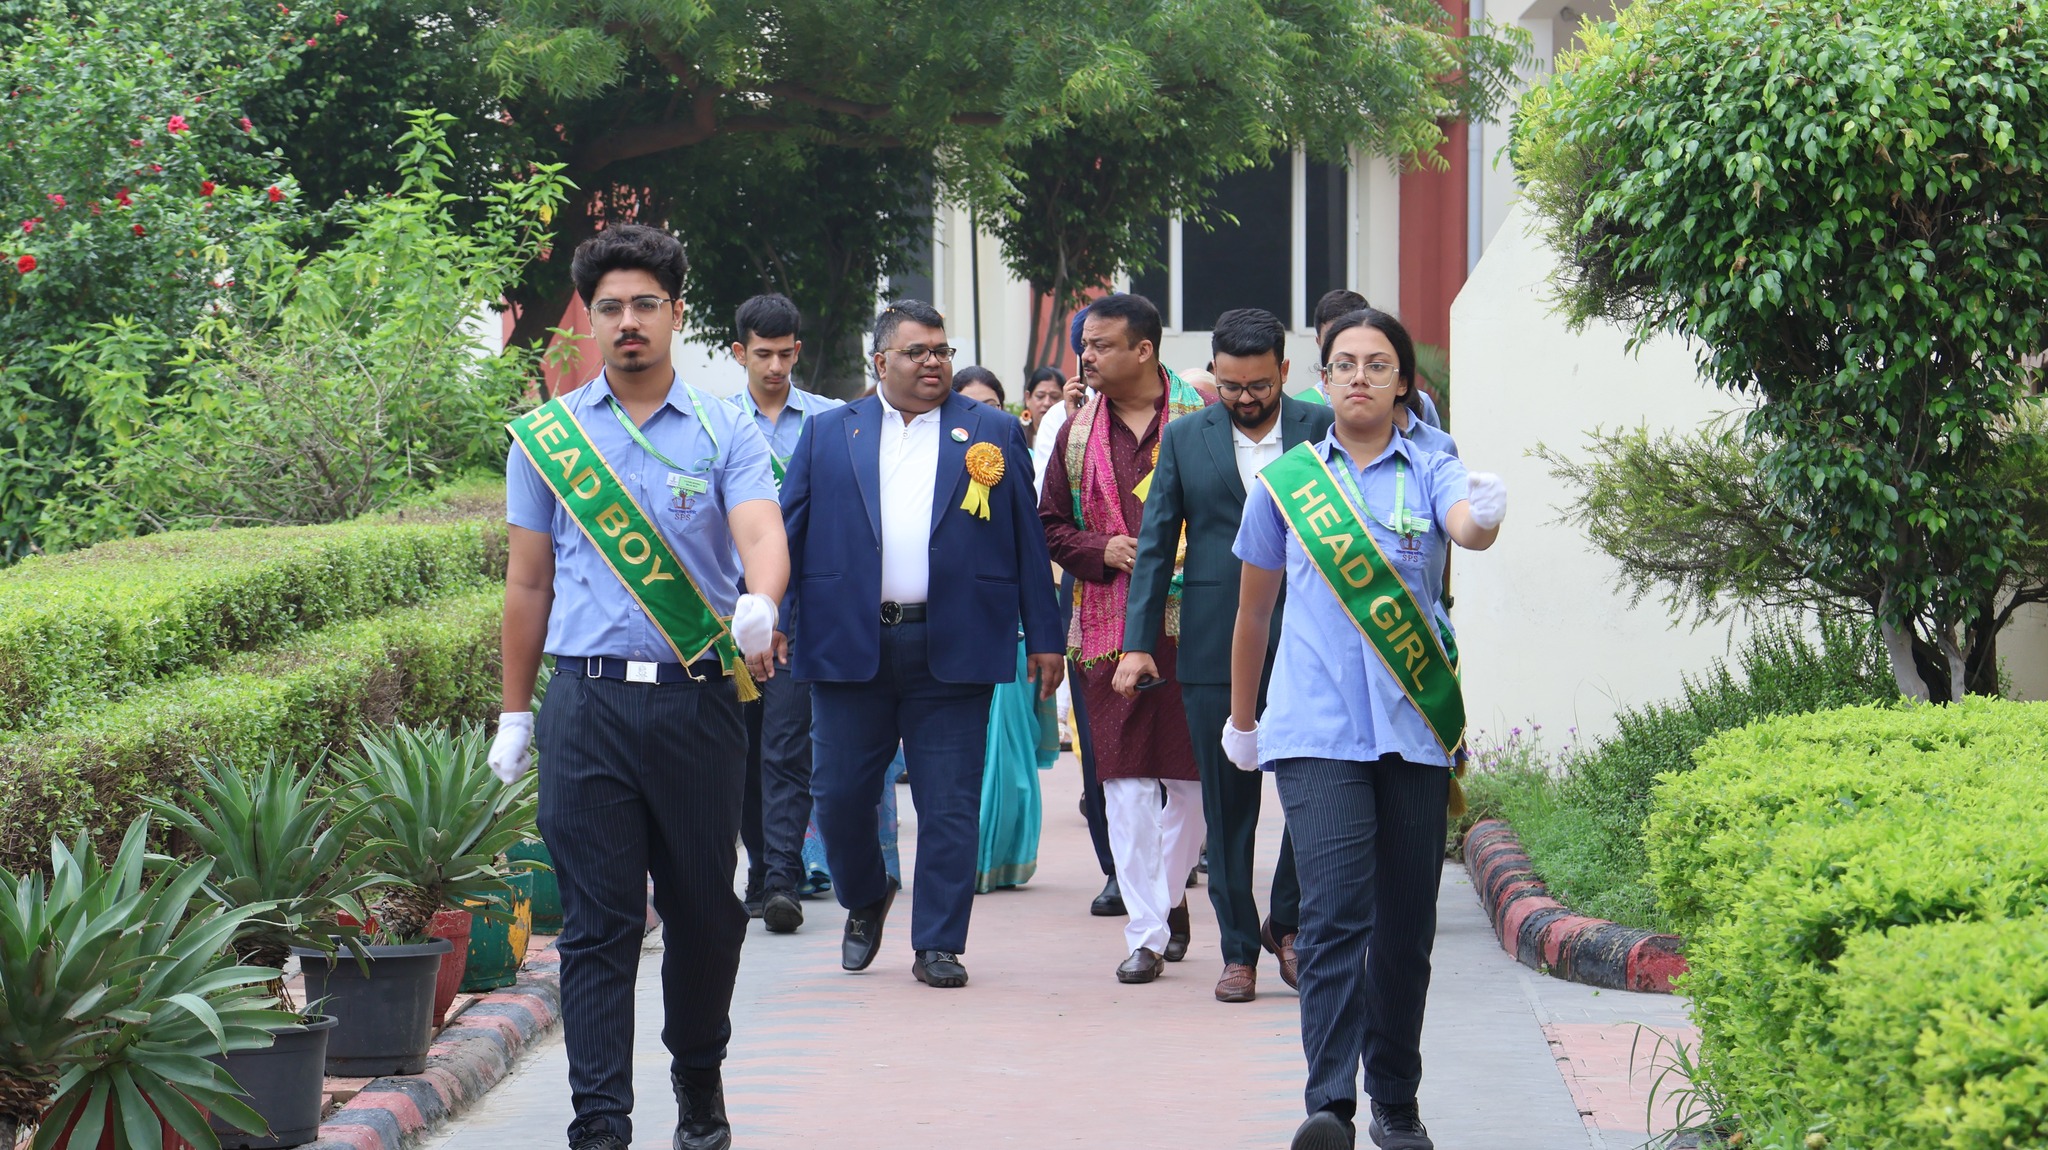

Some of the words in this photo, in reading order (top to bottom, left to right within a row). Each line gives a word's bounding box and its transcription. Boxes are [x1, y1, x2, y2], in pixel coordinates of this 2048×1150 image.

[521, 404, 601, 500] HEAD
[594, 502, 675, 586] BOY
[674, 513, 692, 521] SPS
[1291, 479, 1375, 589] HEAD
[1369, 595, 1431, 692] GIRL
[1402, 554, 1419, 563] SPS
